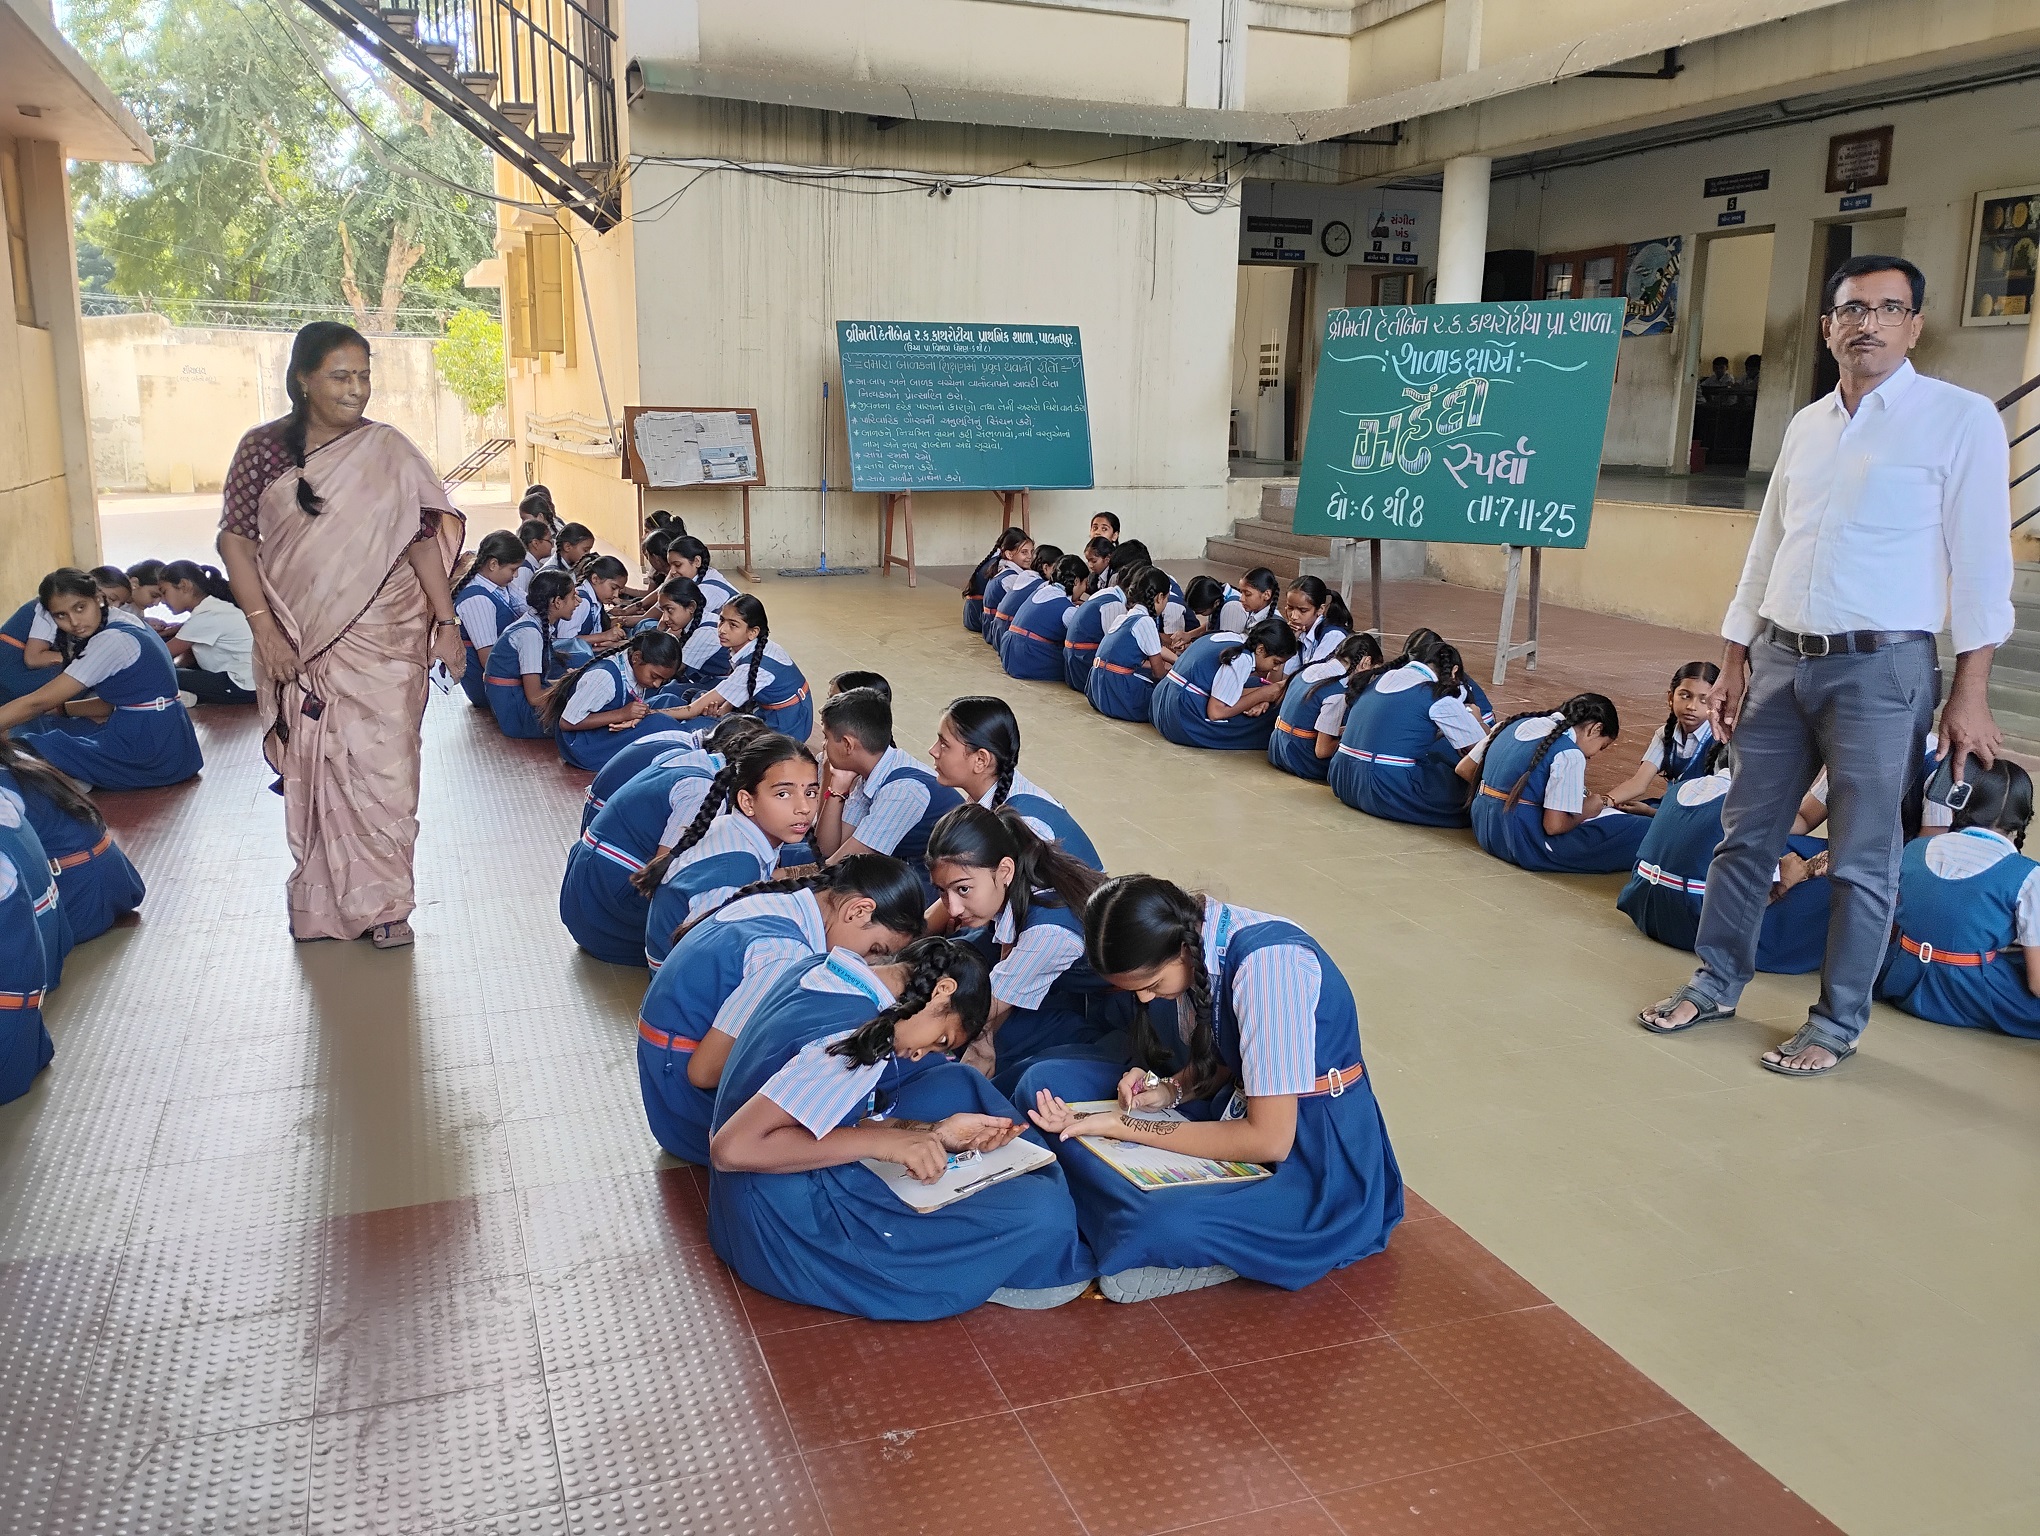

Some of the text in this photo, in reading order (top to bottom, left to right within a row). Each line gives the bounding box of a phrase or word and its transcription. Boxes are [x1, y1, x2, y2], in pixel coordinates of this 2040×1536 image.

[1729, 199, 1735, 209] 5
[1390, 213, 1416, 226] સંગીત
[1395, 227, 1409, 238] ખંડ
[1327, 308, 1372, 340] શ્રીમતી
[845, 322, 878, 343] શ્રીમતી
[896, 361, 936, 371] બાળકના
[888, 373, 906, 387] અને
[909, 378, 934, 387] બાળક
[1442, 436, 1537, 489] સ્પર્ધા
[1382, 486, 1409, 527] થી
[1407, 494, 1425, 528] 8
